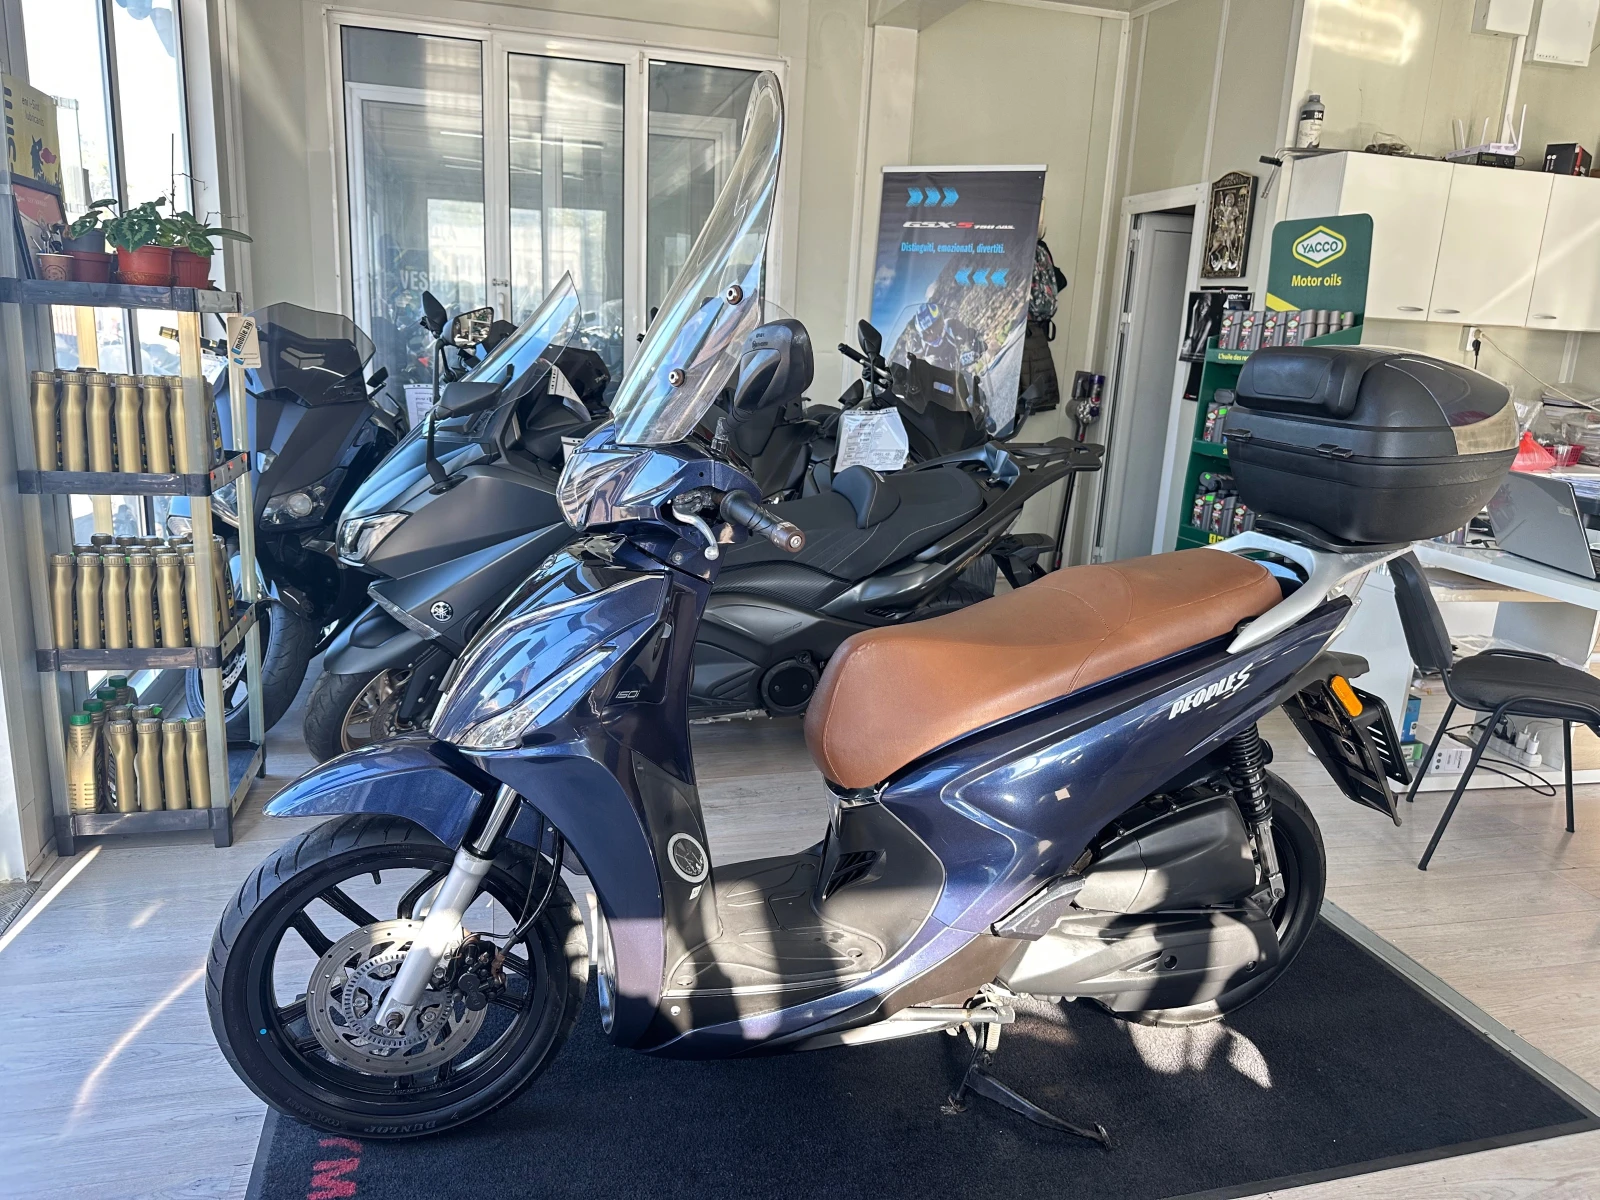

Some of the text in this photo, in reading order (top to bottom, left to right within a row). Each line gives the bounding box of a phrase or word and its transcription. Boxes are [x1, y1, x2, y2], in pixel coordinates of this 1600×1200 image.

[901, 242, 1005, 254] Distinguiti, emozionati, divertiti.
[1301, 241, 1339, 254] YACCO
[1291, 273, 1342, 287] Motor oils
[235, 321, 253, 350] mobile.bg
[363, 1119, 437, 1134] DUNLOP
